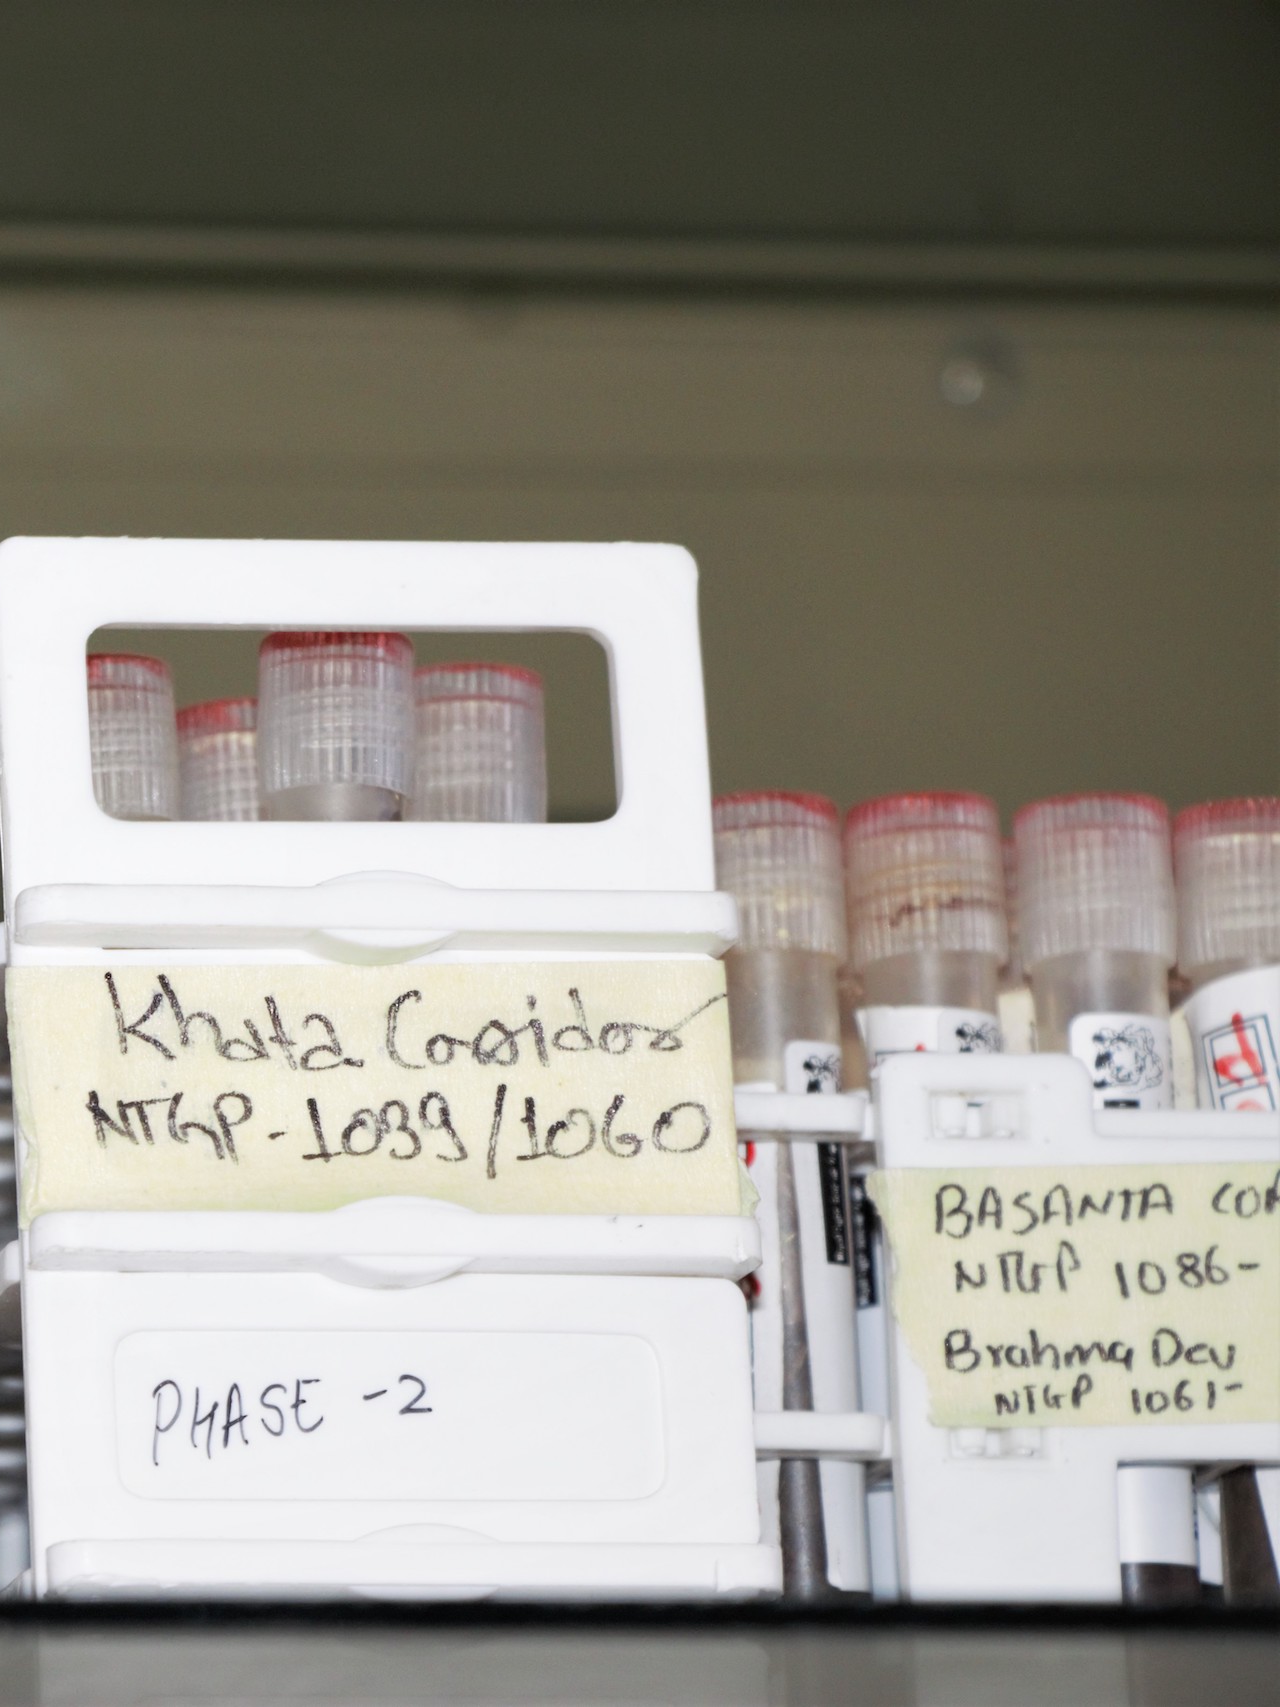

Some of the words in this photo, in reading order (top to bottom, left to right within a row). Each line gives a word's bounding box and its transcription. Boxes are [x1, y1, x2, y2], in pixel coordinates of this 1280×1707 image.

[103, 971, 365, 1072] Khata
[934, 1182, 1174, 1239] BASANTA
[943, 1328, 1135, 1374] Brahma
[1150, 1327, 1237, 1370] Dev
[151, 1378, 324, 1467] PHASE
[993, 1373, 1094, 1416] NTGP
